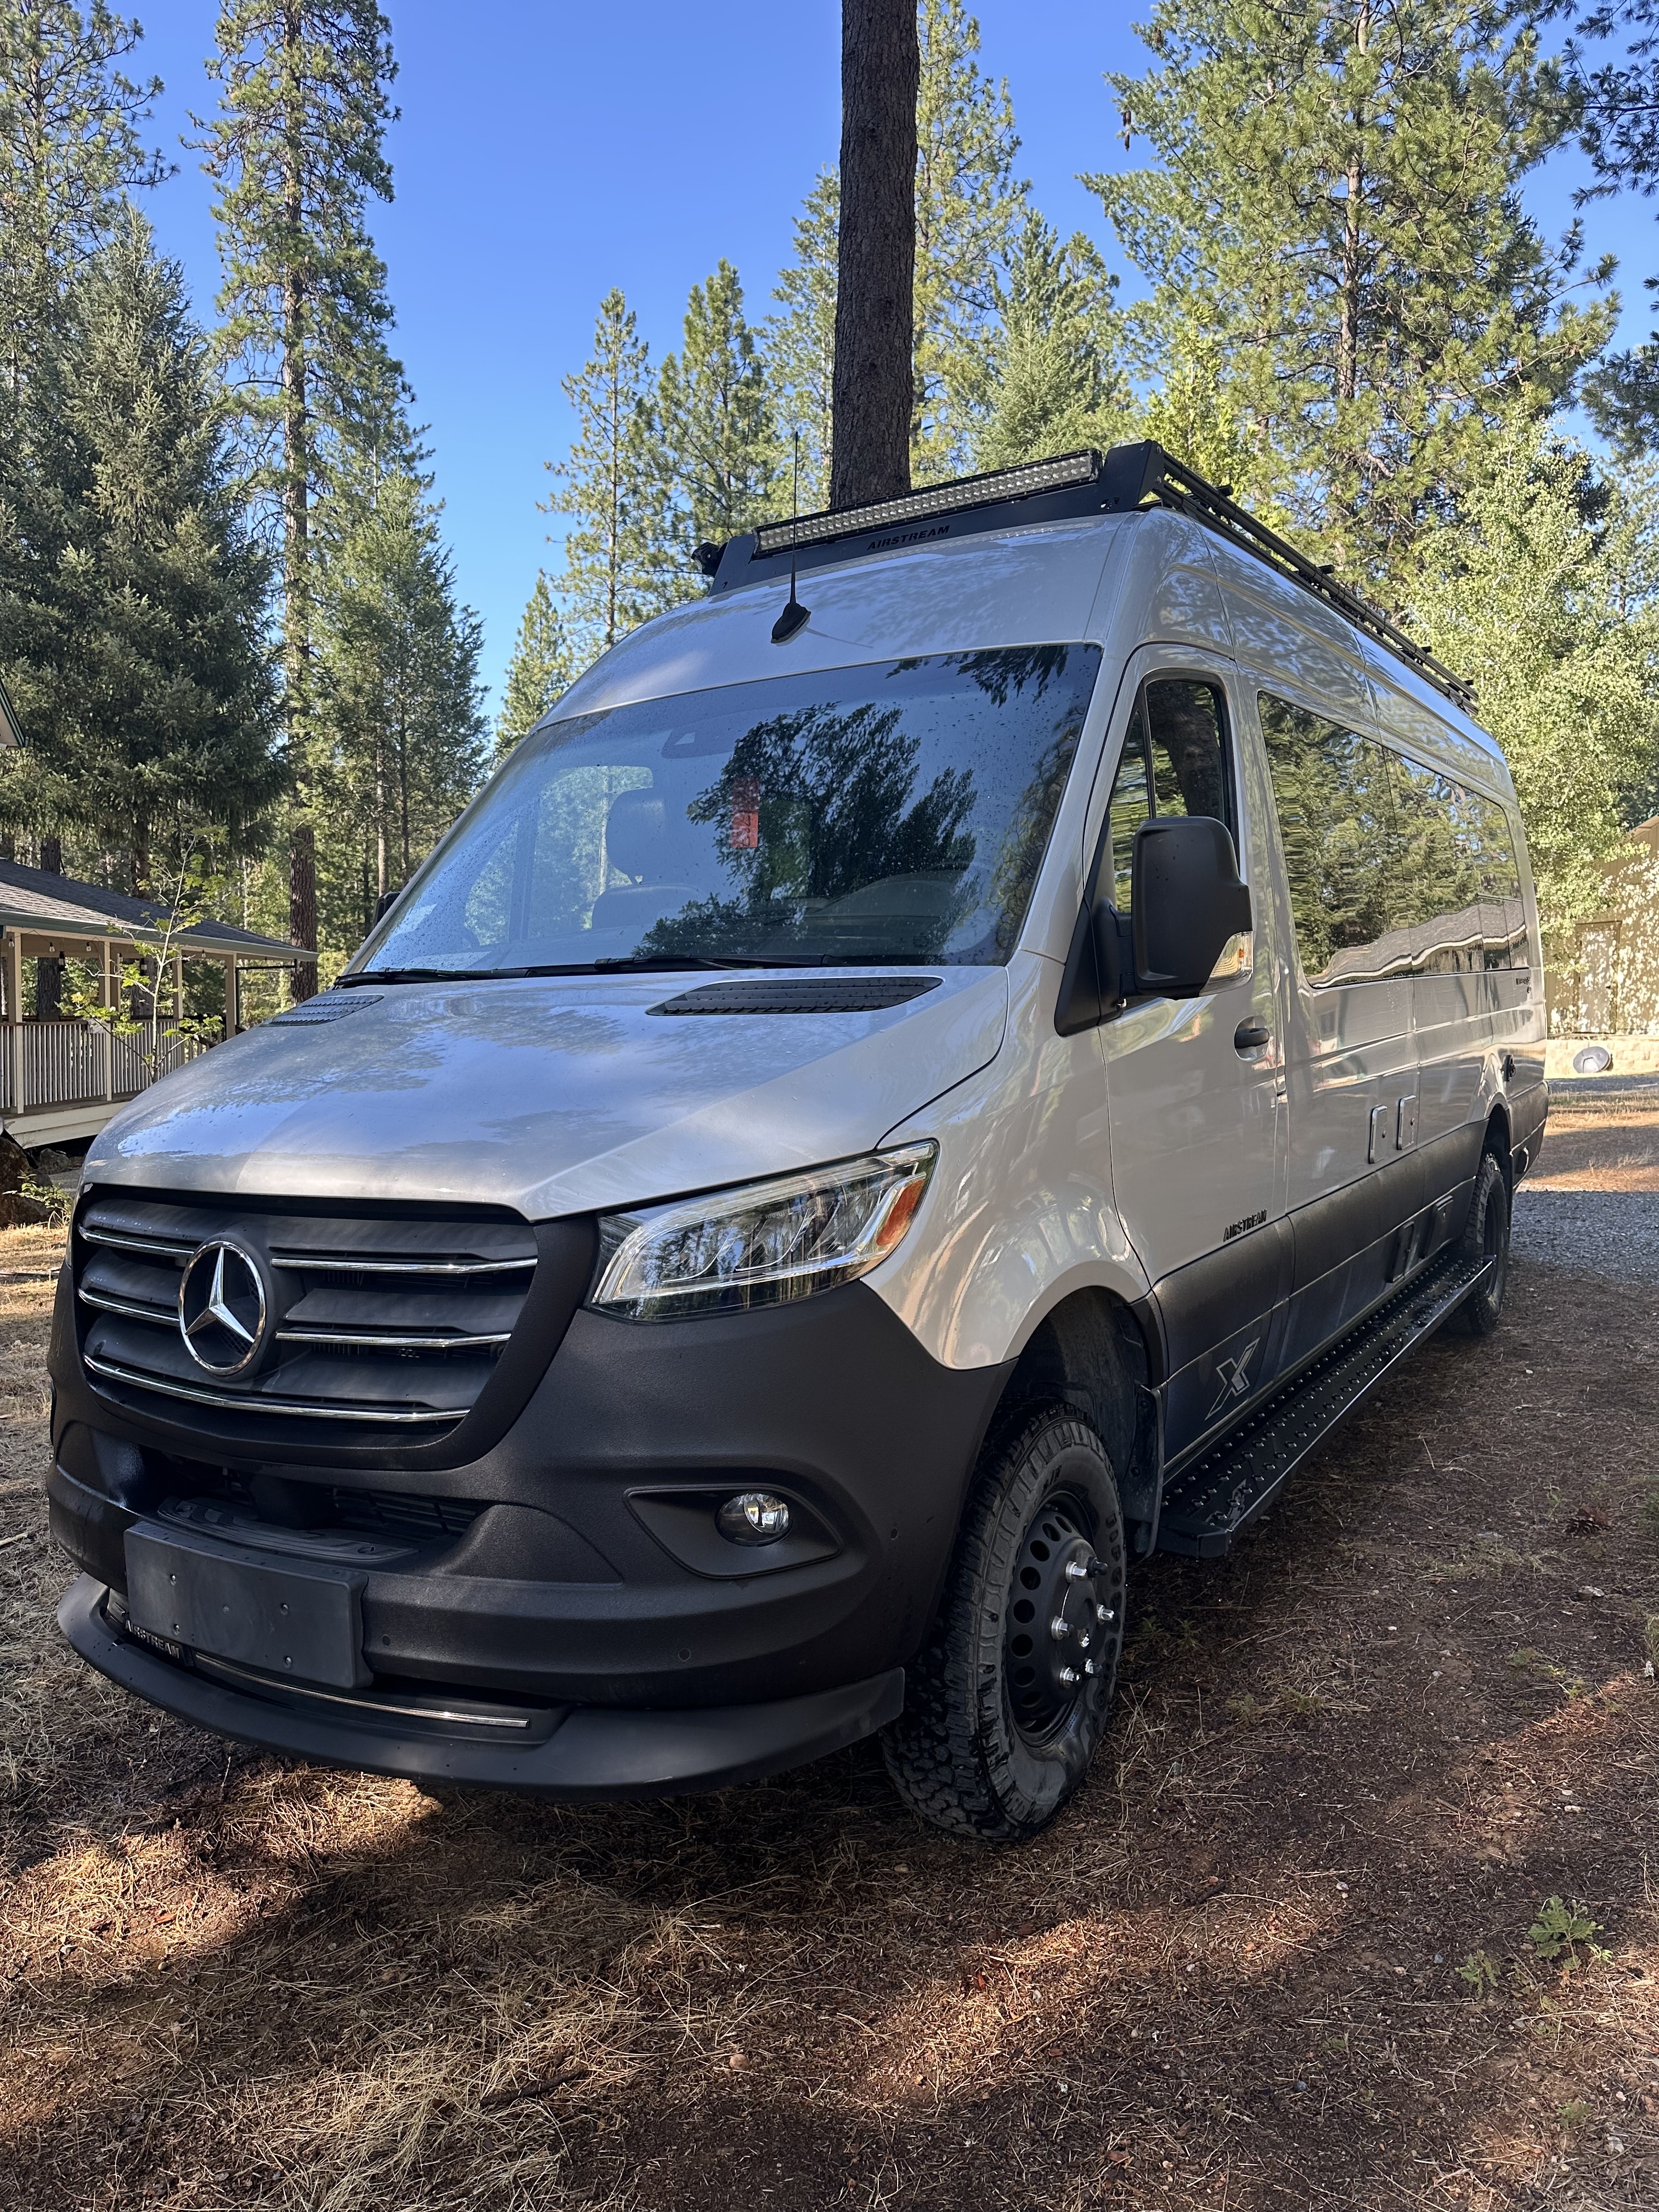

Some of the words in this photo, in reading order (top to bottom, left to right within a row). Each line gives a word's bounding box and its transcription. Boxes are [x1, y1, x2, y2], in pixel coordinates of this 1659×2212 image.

[866, 525, 950, 550] AIRSTREAM
[1223, 1209, 1268, 1243] AIRSTREAM
[125, 1620, 180, 1659] AIRSTREAM
